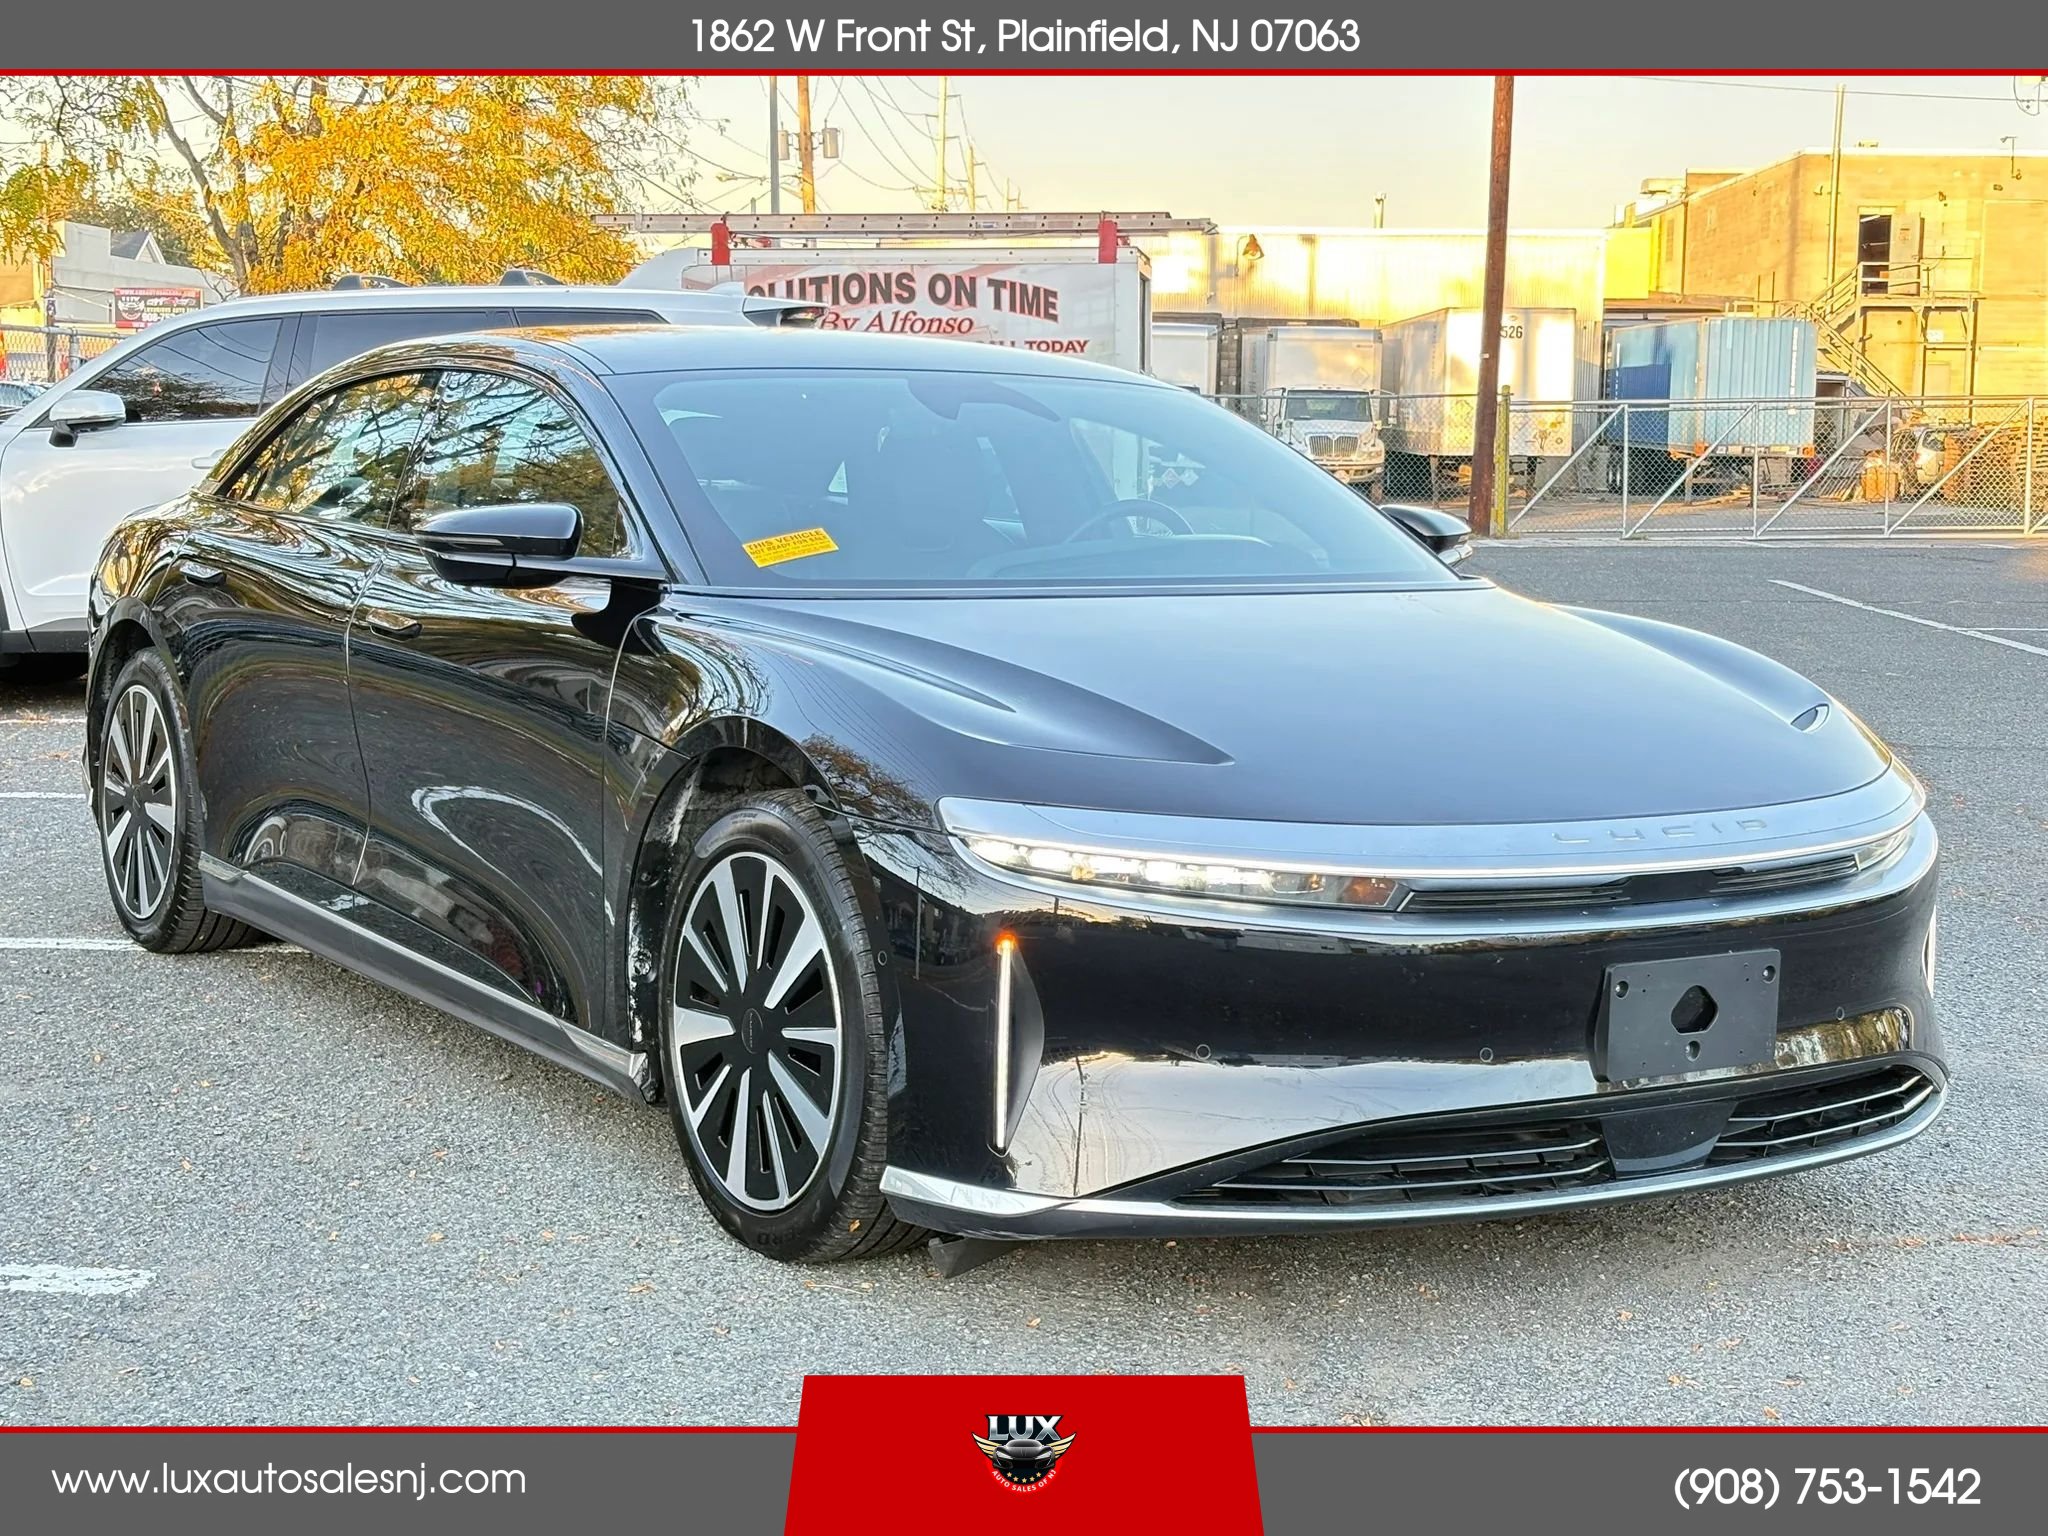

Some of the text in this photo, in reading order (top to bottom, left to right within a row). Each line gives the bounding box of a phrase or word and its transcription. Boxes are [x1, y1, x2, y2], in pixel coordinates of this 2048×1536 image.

[928, 273, 977, 308] ON
[987, 278, 1059, 323] TIME
[821, 310, 974, 335] By Alfonso
[1024, 340, 1089, 353] TODAY
[748, 530, 823, 550] THIS VEHICLE
[1551, 819, 1768, 843] LUCID
